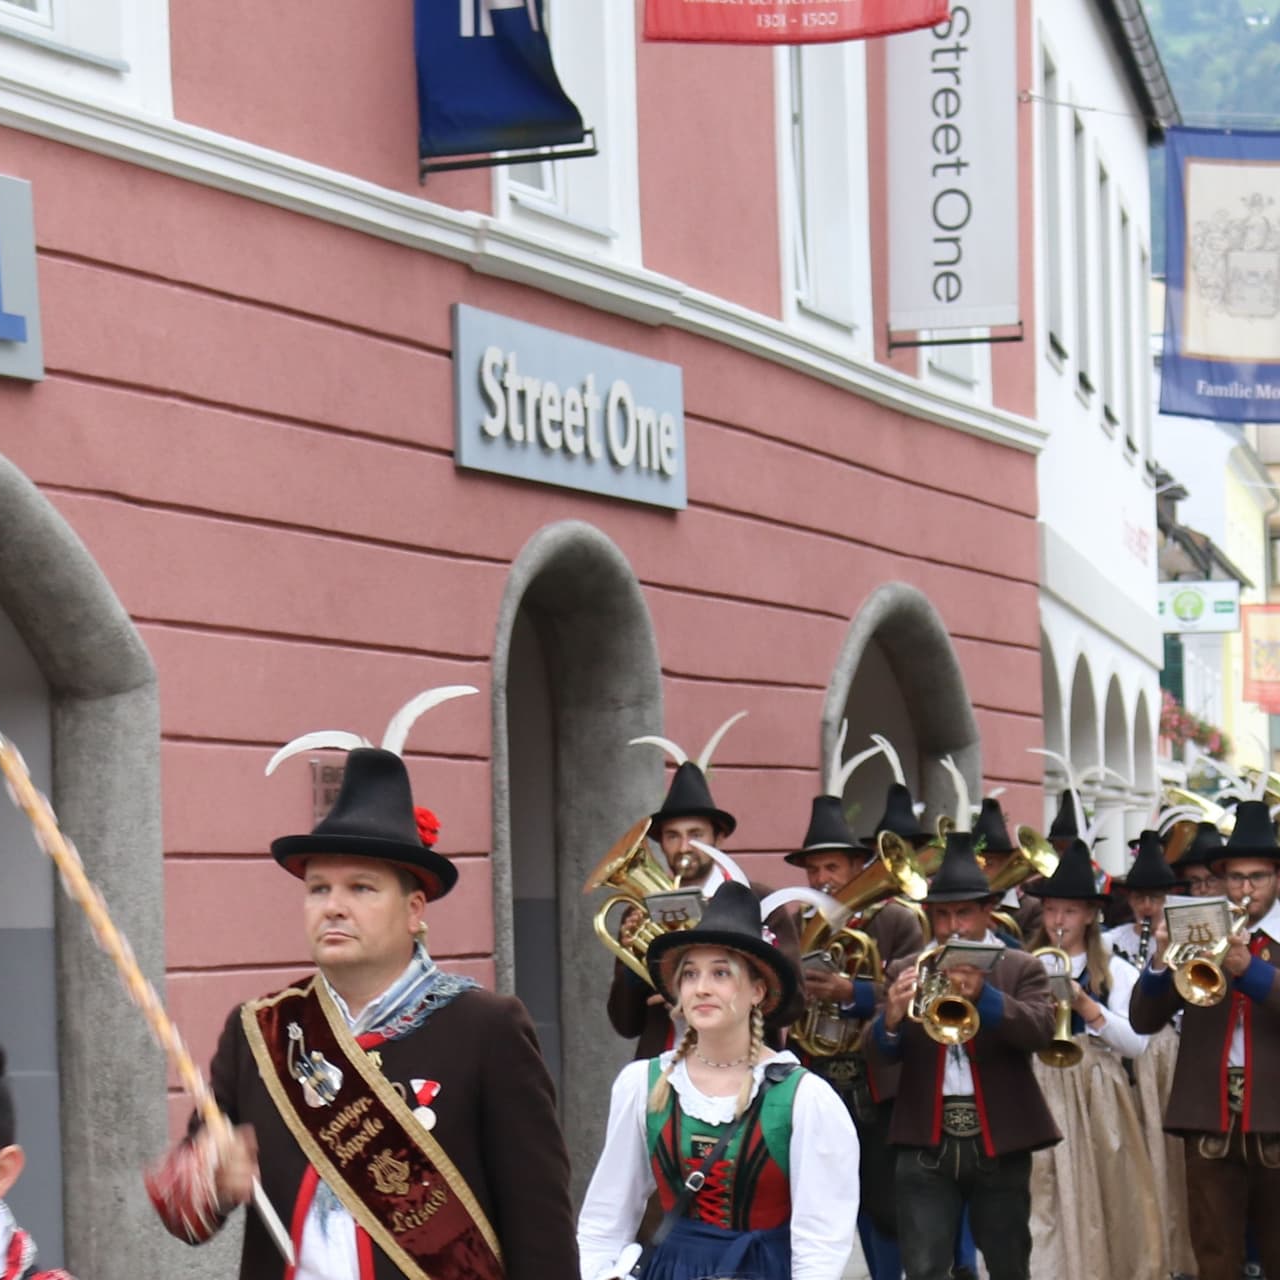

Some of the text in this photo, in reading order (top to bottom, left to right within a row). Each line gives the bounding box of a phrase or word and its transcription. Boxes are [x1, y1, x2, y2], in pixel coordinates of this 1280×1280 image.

[931, 5, 972, 304] Street One
[481, 346, 679, 476] Street One
[1196, 380, 1252, 399] Familie
[393, 1187, 448, 1232] Leisach
